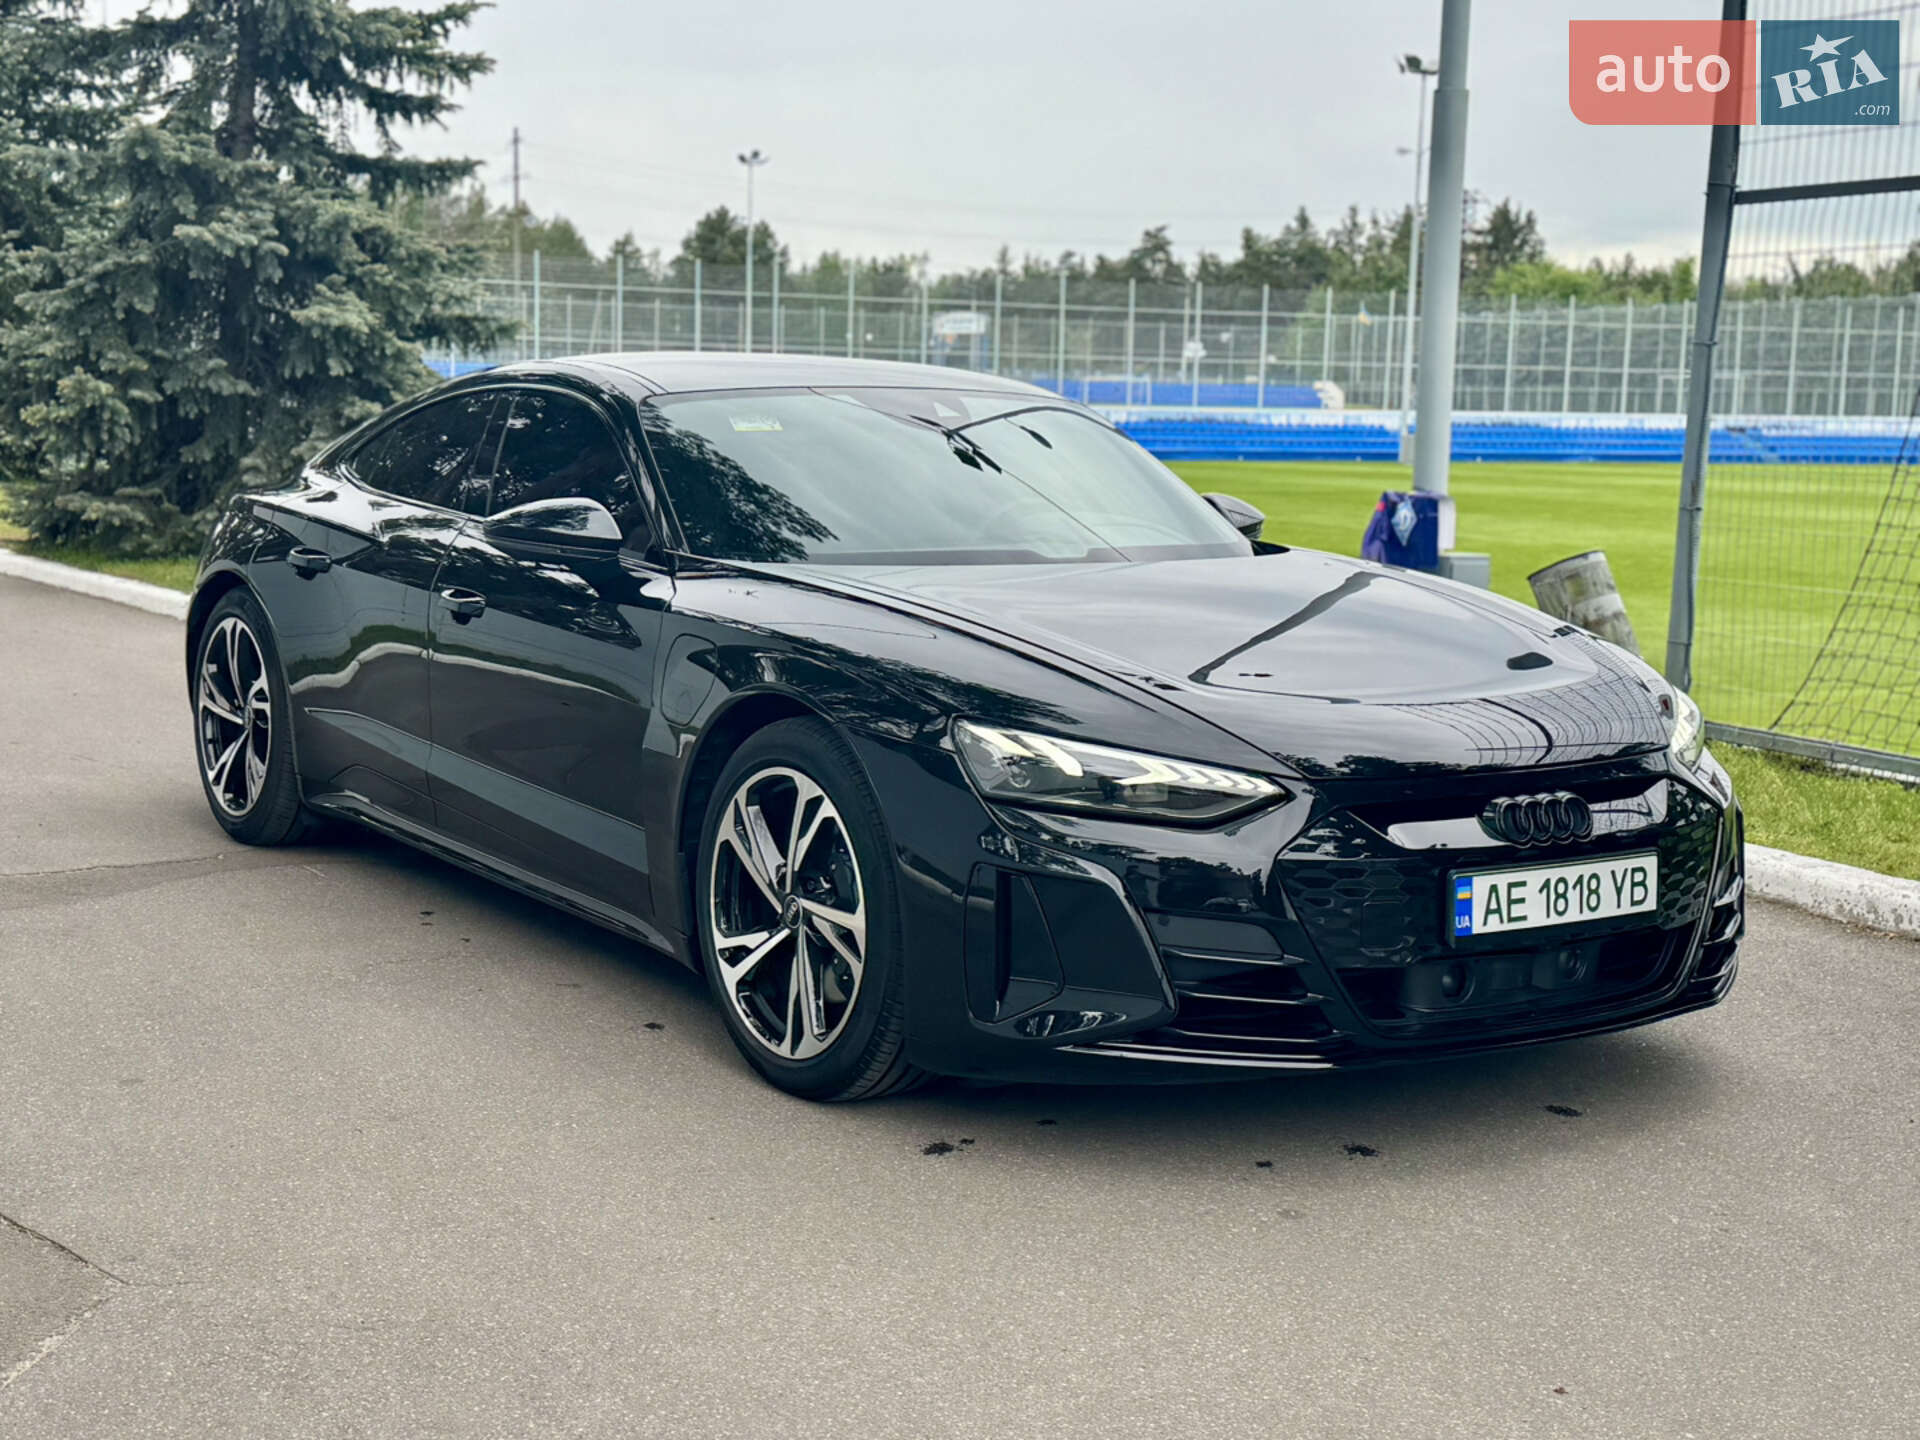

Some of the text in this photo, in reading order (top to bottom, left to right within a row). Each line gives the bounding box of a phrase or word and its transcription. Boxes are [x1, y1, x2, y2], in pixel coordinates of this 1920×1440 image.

[1482, 866, 1648, 927] AE 1818 YB
[1455, 915, 1471, 928] UA
